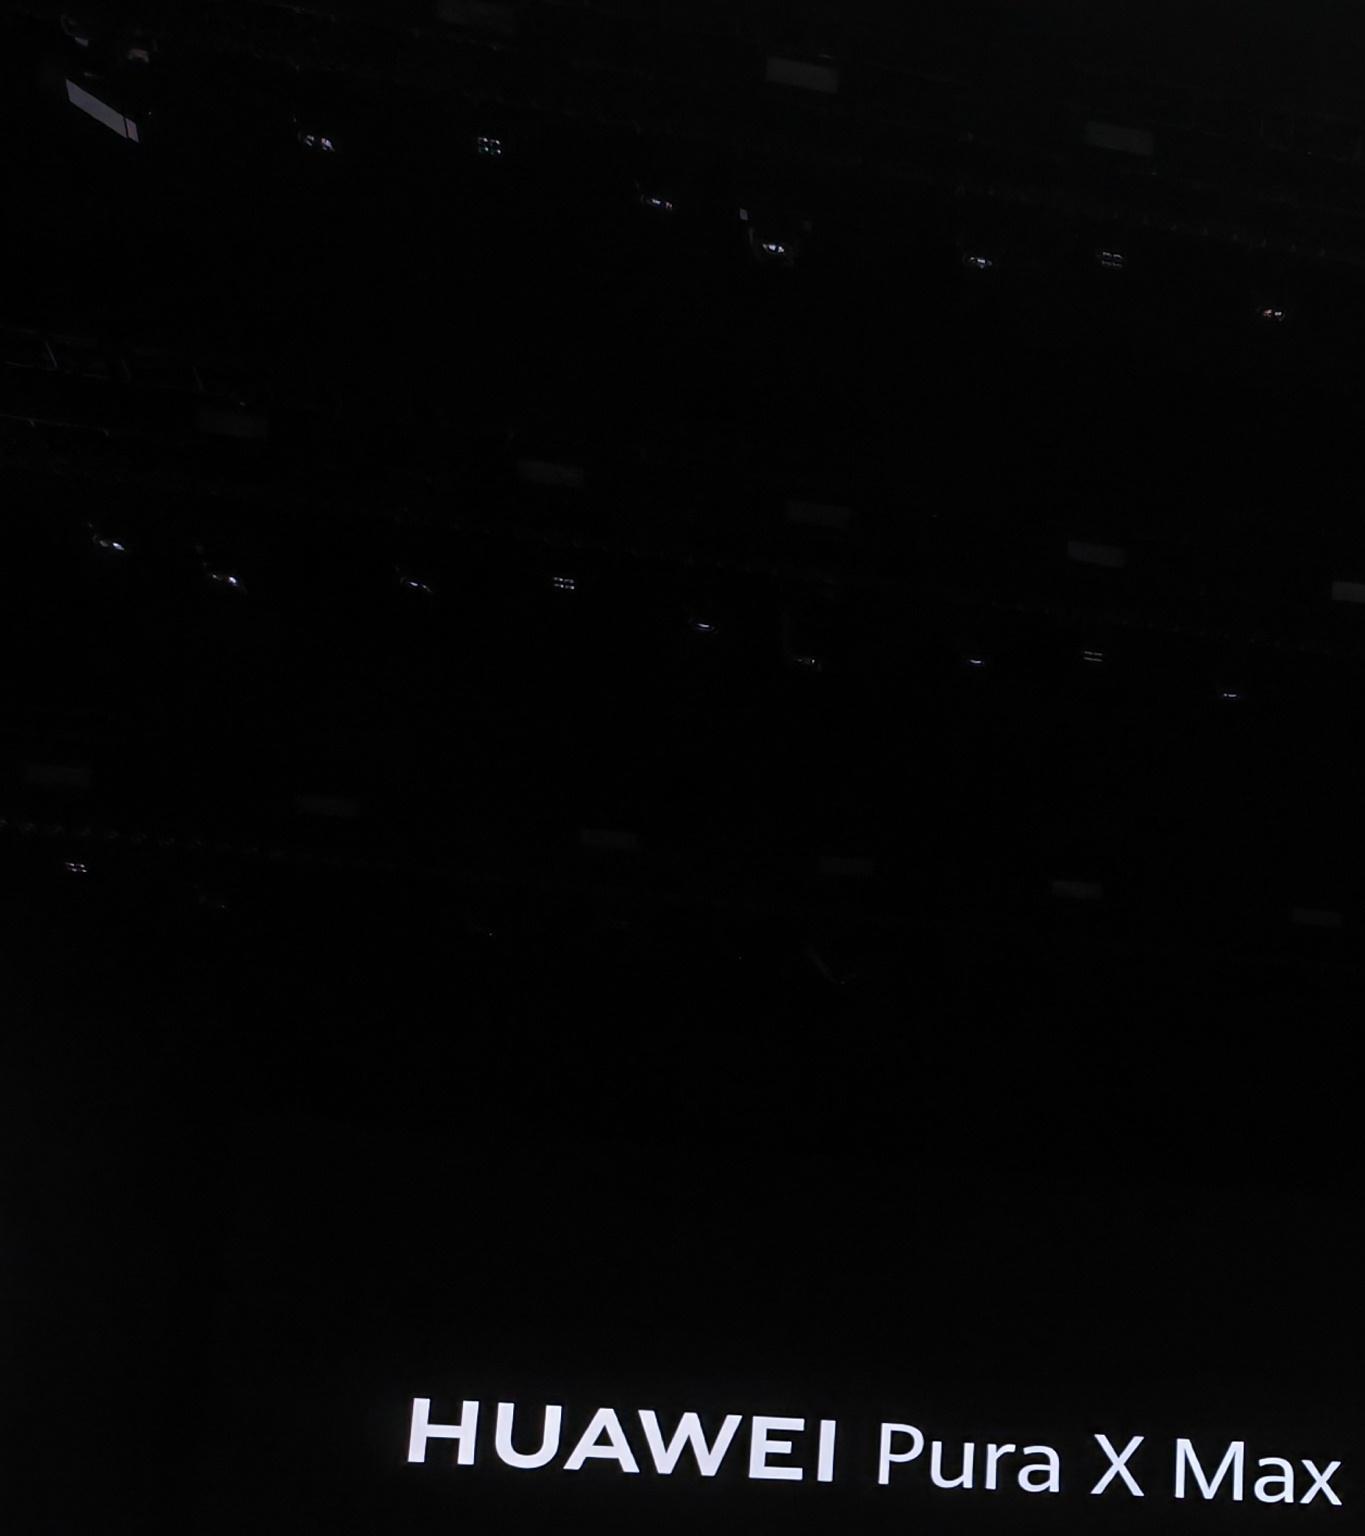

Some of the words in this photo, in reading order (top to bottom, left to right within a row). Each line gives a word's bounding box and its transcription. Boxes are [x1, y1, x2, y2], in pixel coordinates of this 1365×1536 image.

[407, 1397, 837, 1483] HUAWEI
[877, 1422, 1060, 1493] Pura
[1090, 1433, 1145, 1497] X
[1174, 1437, 1343, 1506] Max
